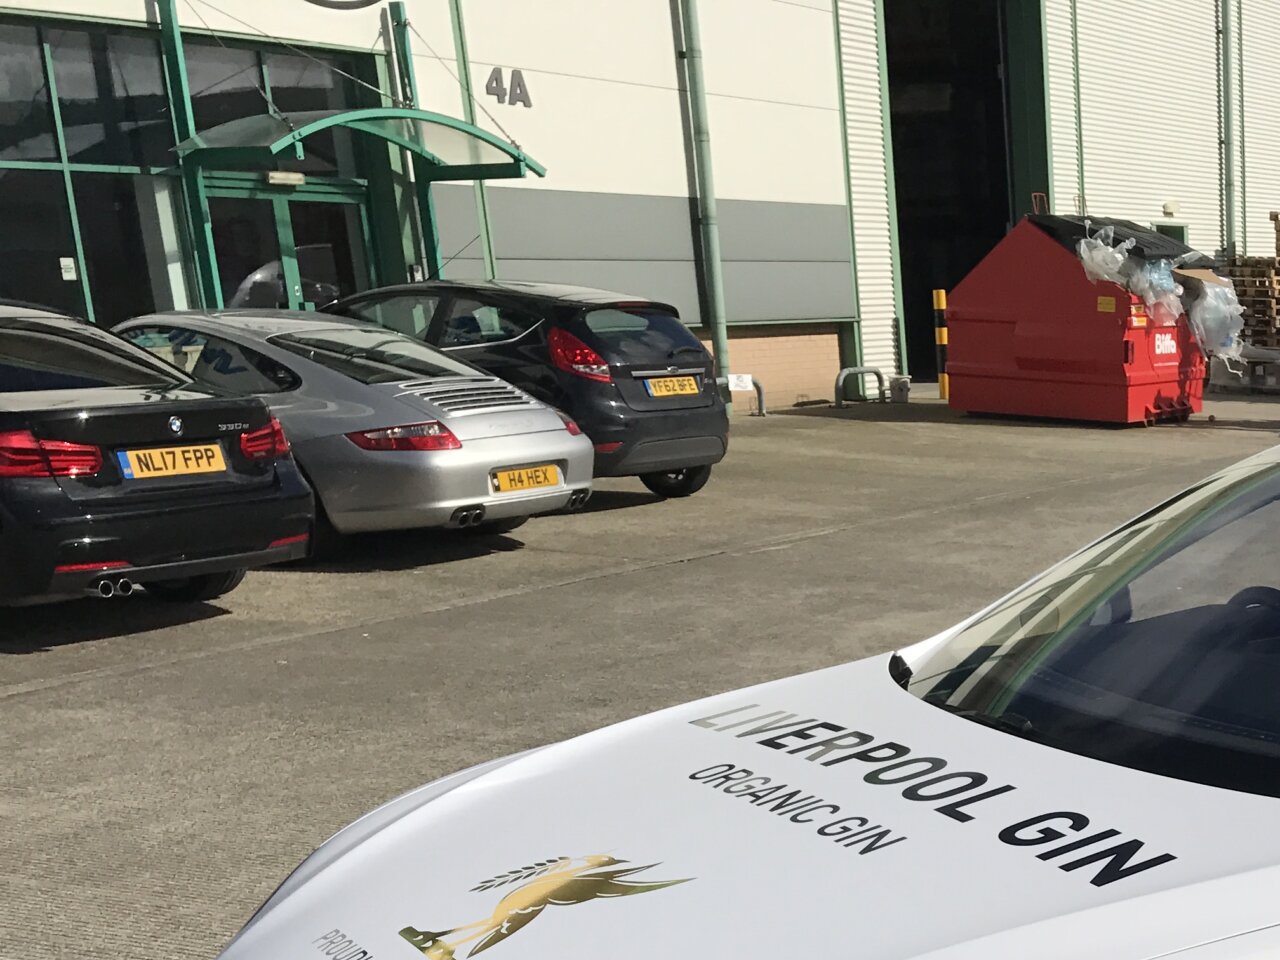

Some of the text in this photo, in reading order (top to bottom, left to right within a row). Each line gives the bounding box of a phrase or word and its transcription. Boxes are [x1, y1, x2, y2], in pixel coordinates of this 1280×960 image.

[485, 66, 532, 108] 4A
[1155, 333, 1177, 355] Biffa
[135, 448, 215, 473] NL17 FPP
[508, 468, 550, 488] H4 HEX
[688, 703, 1178, 888] LIVERPOOL GIN
[688, 763, 908, 855] ORGANIC GIN
